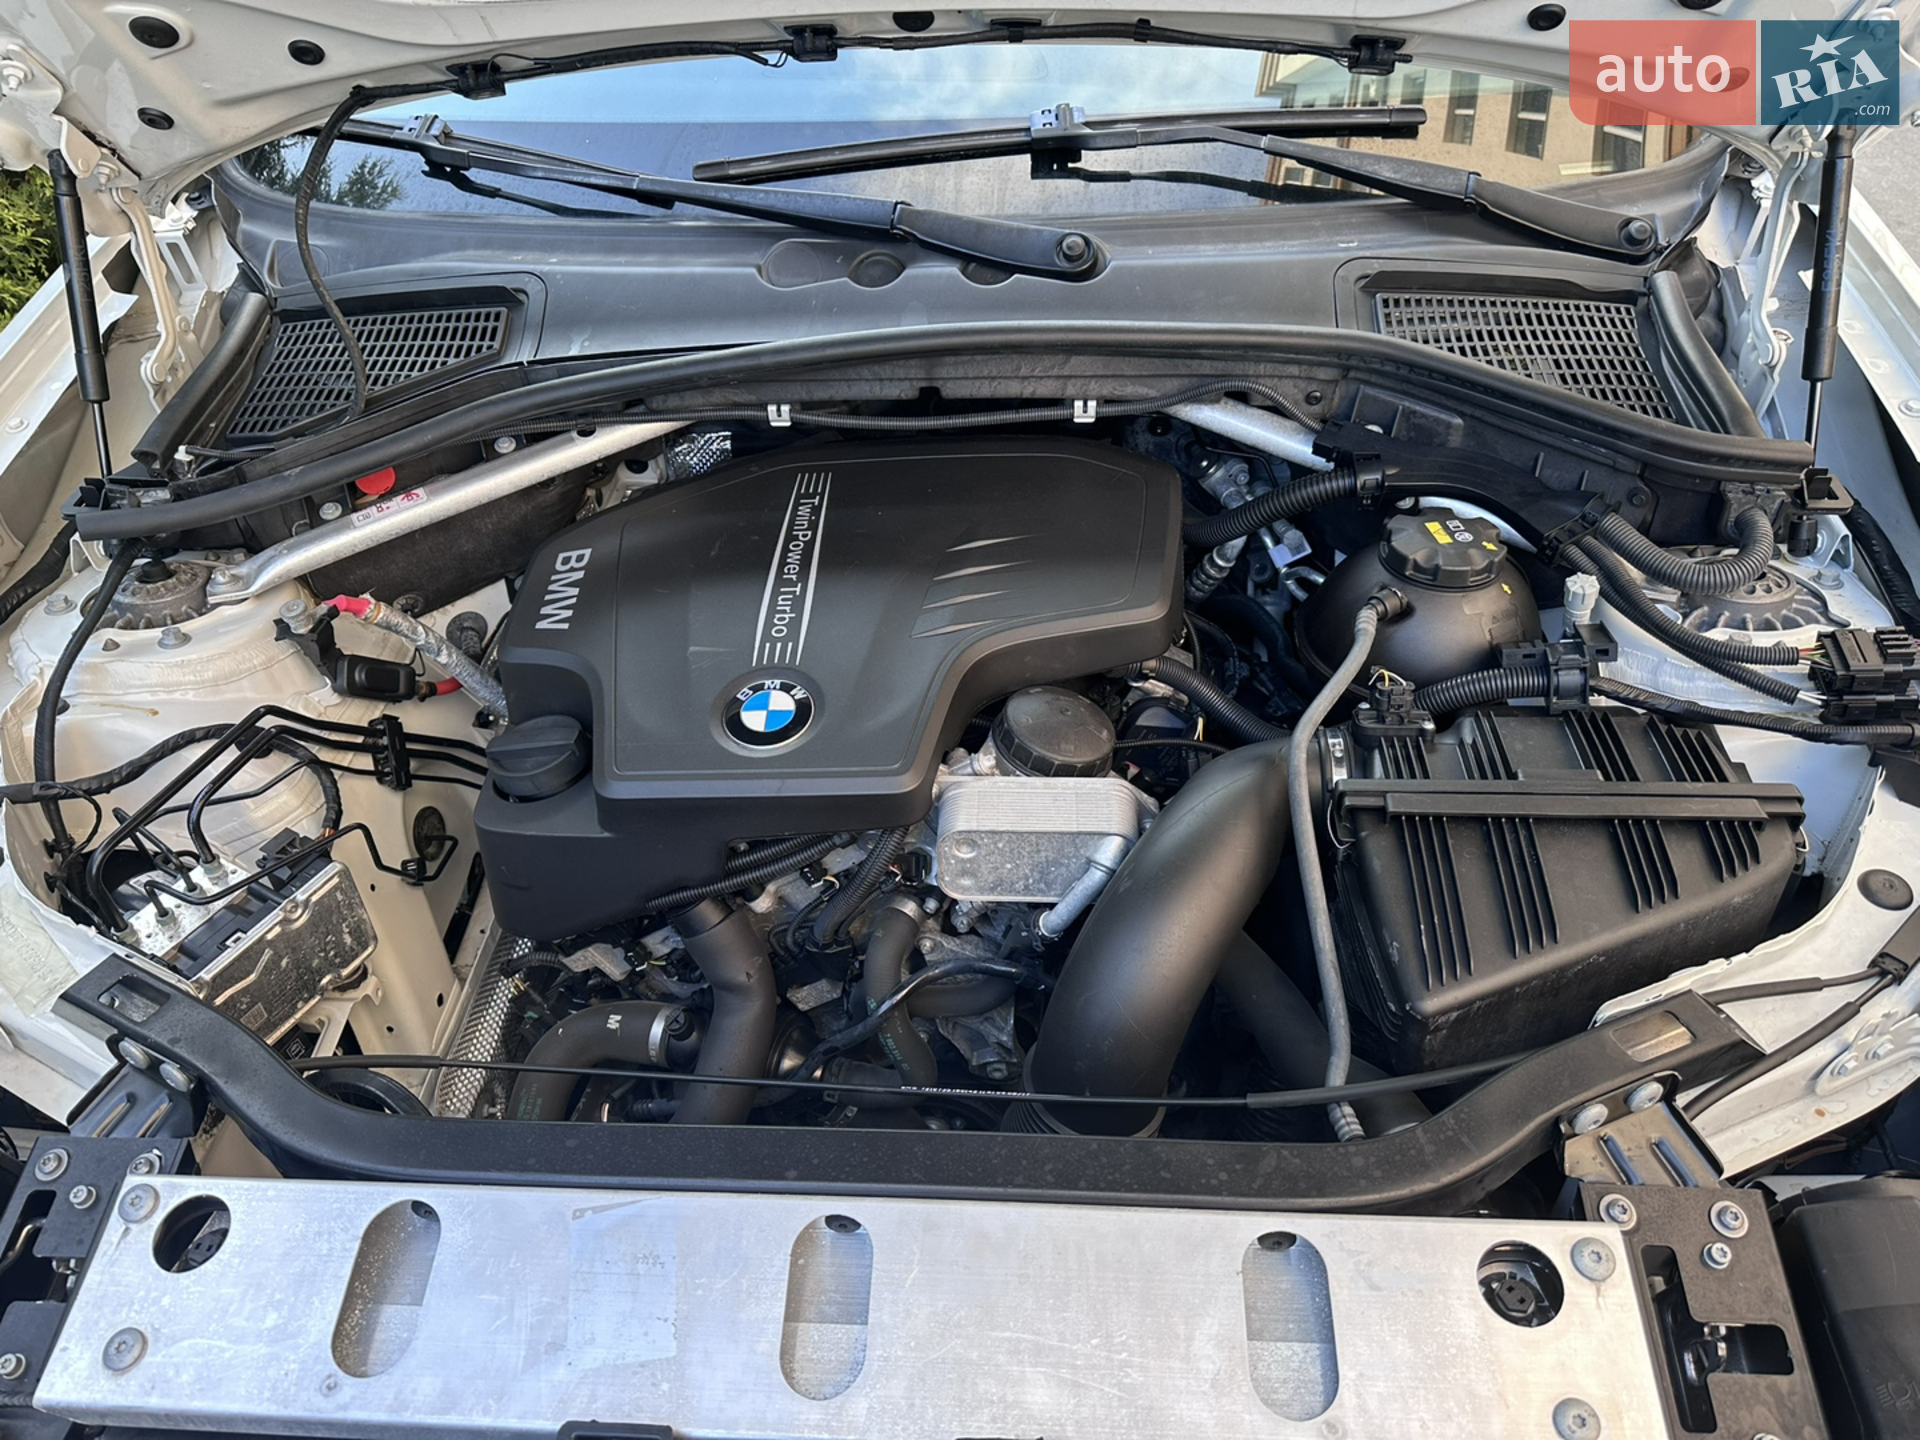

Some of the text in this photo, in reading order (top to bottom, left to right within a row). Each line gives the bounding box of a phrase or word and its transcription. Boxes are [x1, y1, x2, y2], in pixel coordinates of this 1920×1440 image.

[534, 547, 593, 630] BMW
[771, 495, 820, 637] TwinPower Turbo
[736, 680, 808, 701] BMW
